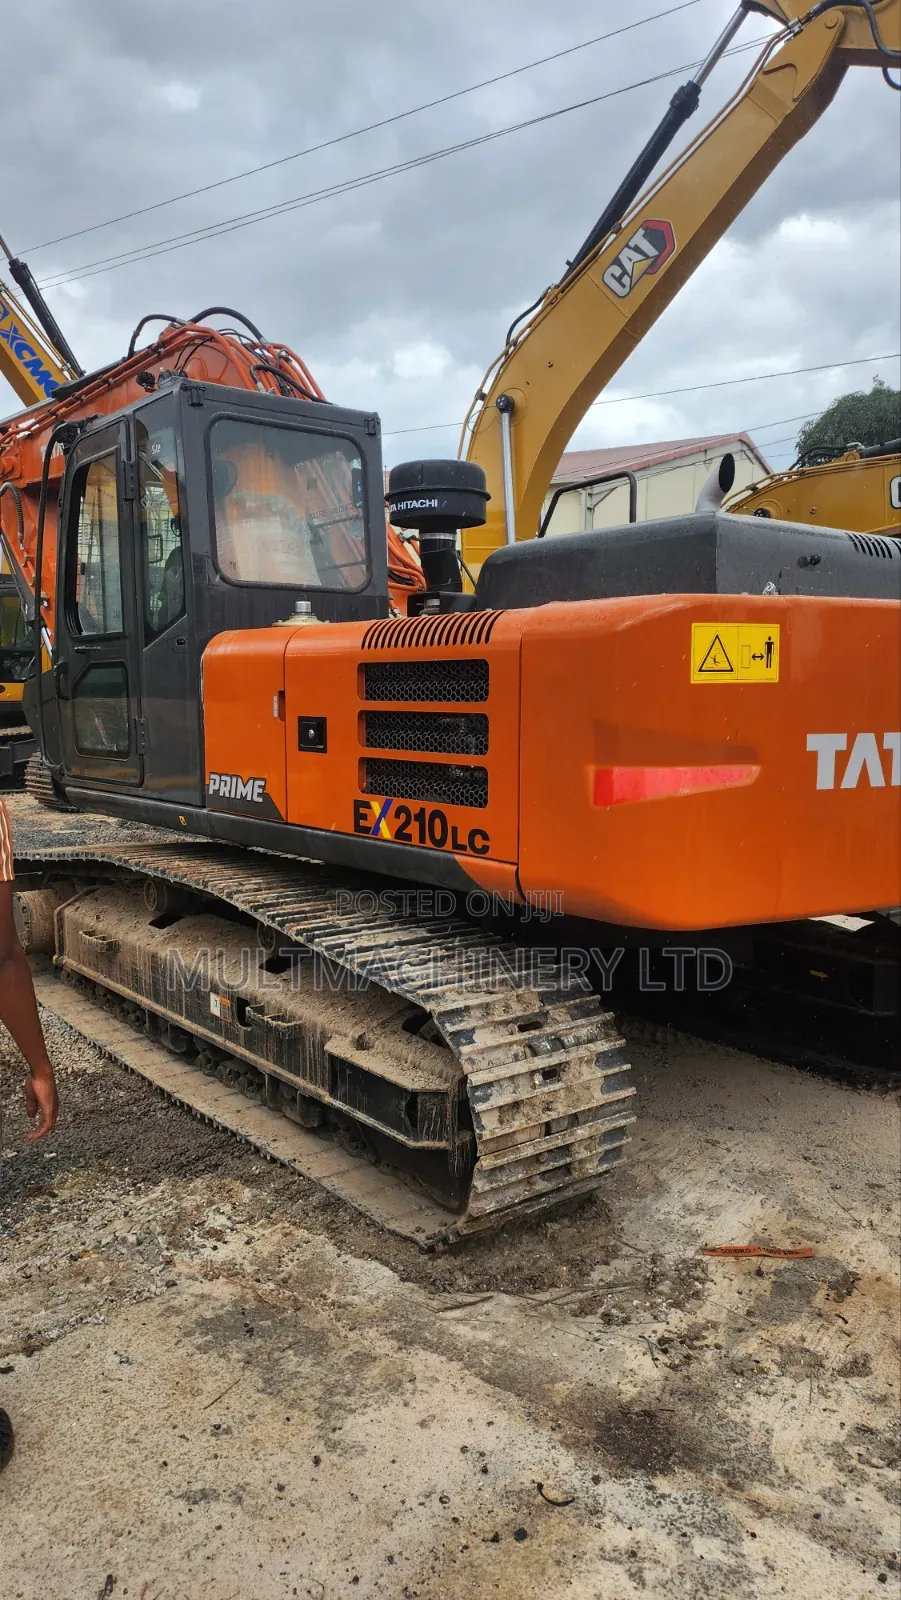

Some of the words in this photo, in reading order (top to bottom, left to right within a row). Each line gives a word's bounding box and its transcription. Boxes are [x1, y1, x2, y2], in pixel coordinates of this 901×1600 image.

[603, 227, 660, 297] CAT
[397, 498, 438, 511] HITACHI
[208, 772, 266, 803] PRIME
